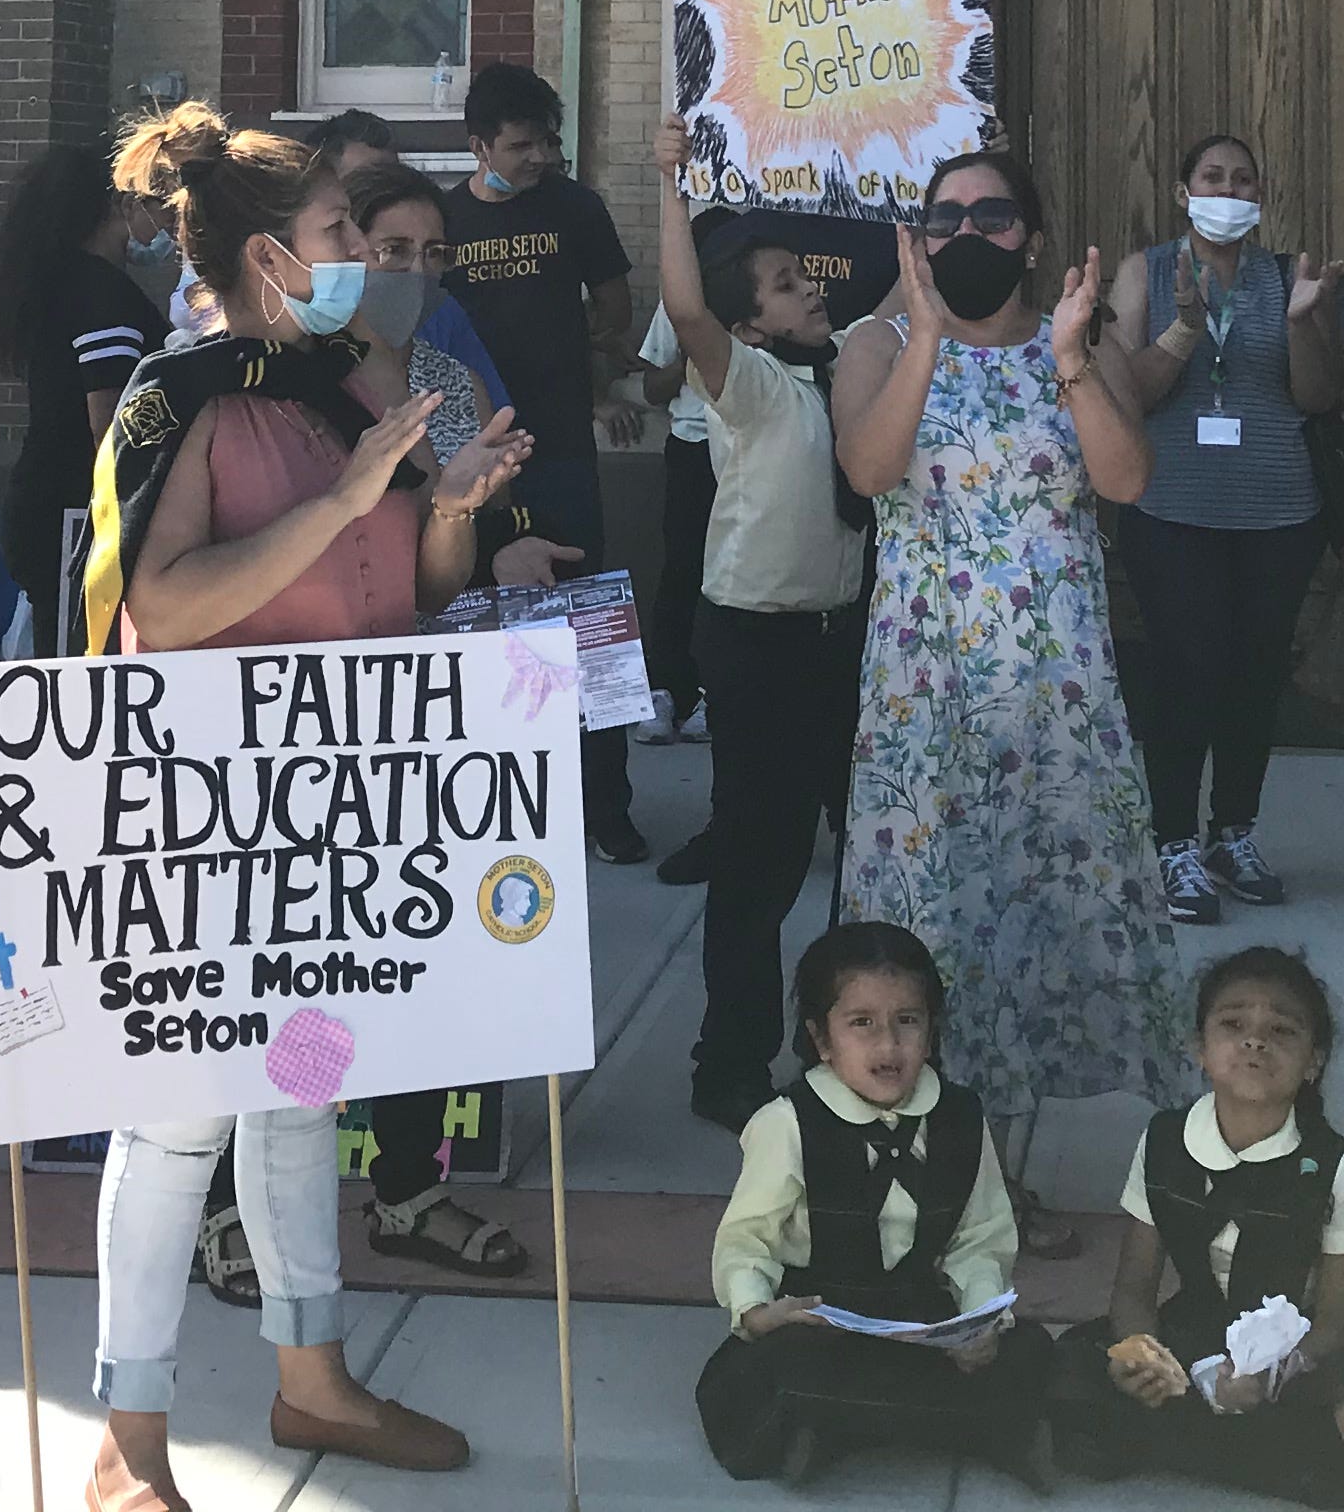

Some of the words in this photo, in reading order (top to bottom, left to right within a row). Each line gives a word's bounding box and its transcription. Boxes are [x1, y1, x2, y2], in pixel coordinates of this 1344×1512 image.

[783, 24, 921, 109] Seton
[691, 169, 710, 196] is
[726, 174, 742, 192] a
[761, 162, 821, 193] spark
[859, 173, 882, 197] of
[896, 170, 919, 201] ho
[468, 259, 541, 283] SCHOOL
[512, 232, 559, 259] SETON
[803, 254, 853, 280] SETON
[237, 652, 467, 749] FAITH
[98, 751, 551, 858] EDUCATION
[42, 844, 454, 968] MATTERS
[99, 960, 225, 1011] Save
[252, 952, 426, 998] Mother
[123, 1010, 268, 1056] Seton
